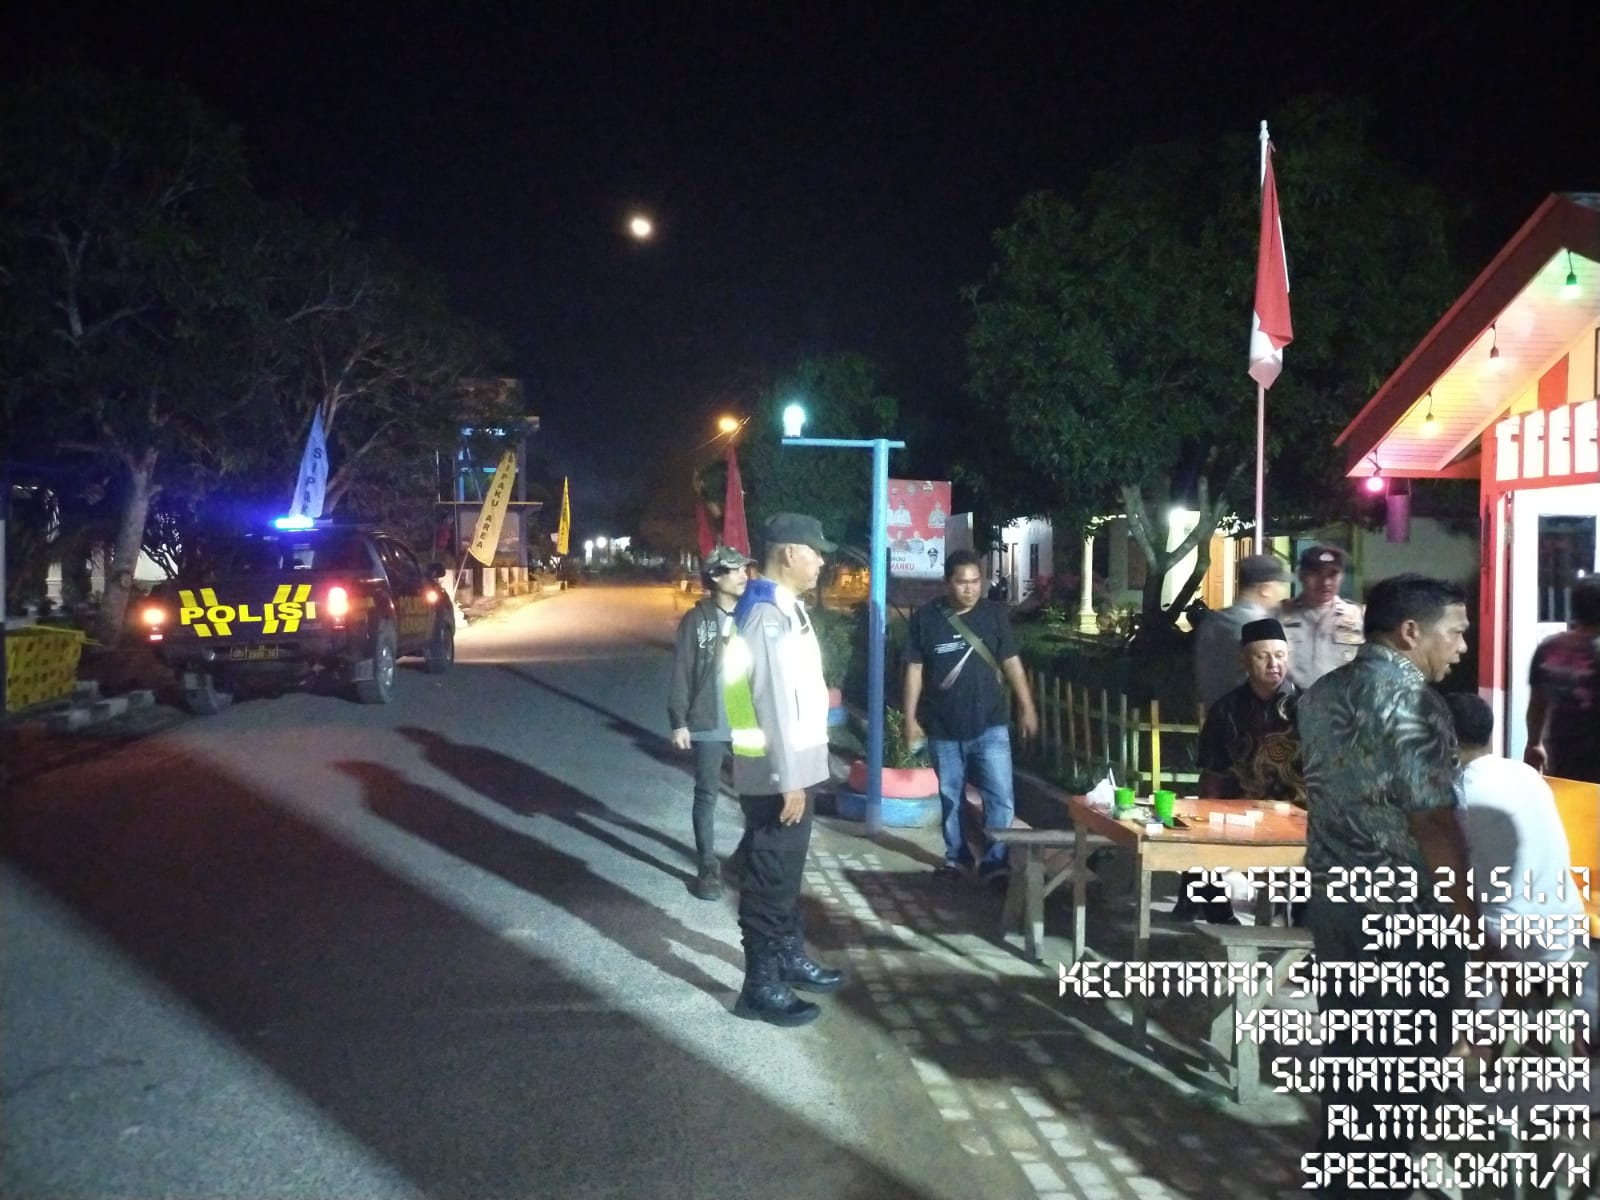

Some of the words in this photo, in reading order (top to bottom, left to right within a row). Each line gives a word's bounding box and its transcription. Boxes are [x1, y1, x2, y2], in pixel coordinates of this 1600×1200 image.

[491, 453, 514, 508] SIPAKU
[476, 514, 493, 549] AREA
[180, 601, 316, 625] POLISI
